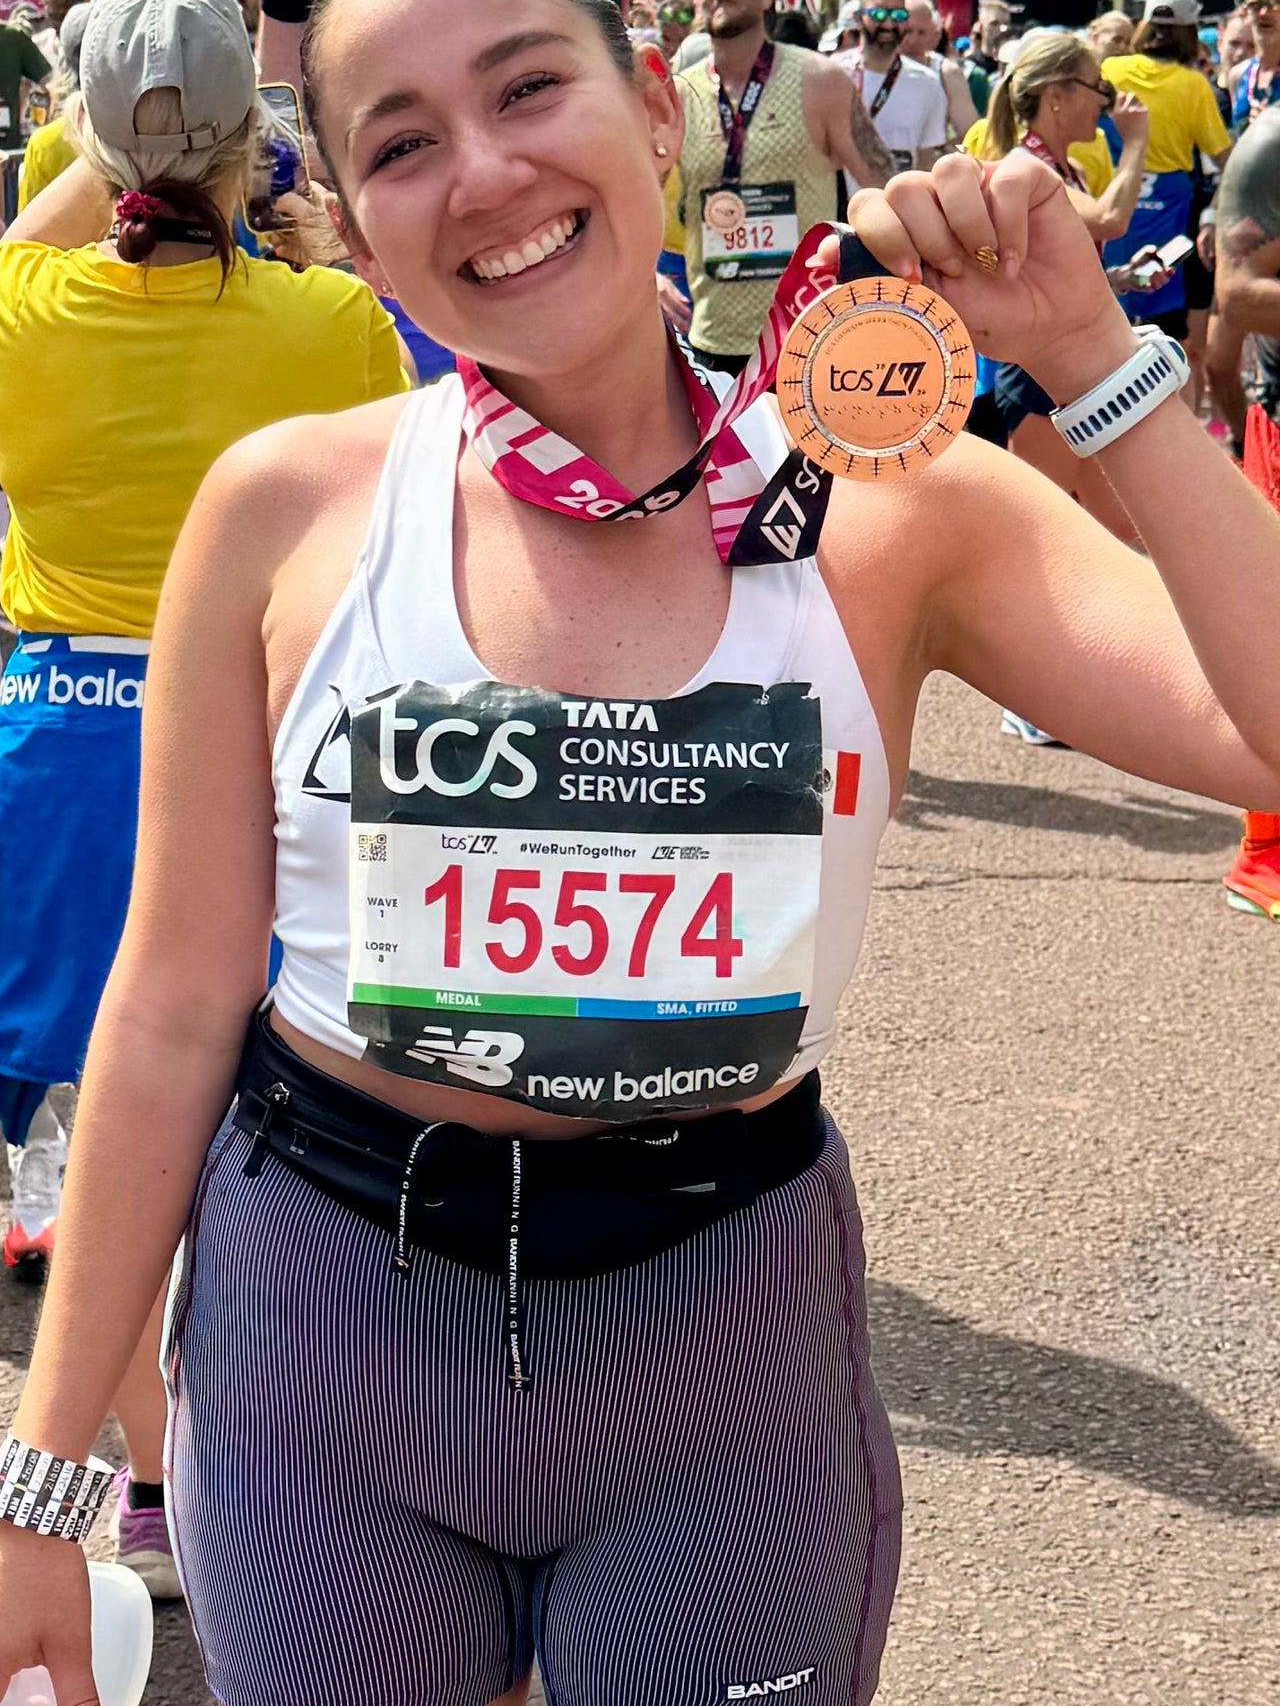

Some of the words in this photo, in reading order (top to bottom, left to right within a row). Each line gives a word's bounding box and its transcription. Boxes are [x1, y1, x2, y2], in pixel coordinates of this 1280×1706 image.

[723, 225, 774, 250] 9812
[829, 364, 873, 392] tcs
[48, 665, 145, 709] bala
[560, 700, 659, 732] TATA
[372, 696, 539, 799] tcs
[559, 738, 789, 769] CONSULTANCY
[557, 775, 706, 805] SERVICES
[441, 833, 467, 850] tcs
[519, 843, 637, 859] #WeRunTogether
[367, 896, 398, 908] WAVE
[424, 863, 744, 978] 15574
[365, 941, 399, 953] LORRY
[436, 992, 481, 1007] MEDAL
[656, 1001, 692, 1016] SMA,
[695, 1000, 737, 1014] FITTED
[527, 1071, 605, 1101] new
[613, 1061, 760, 1102] balance
[726, 1666, 815, 1700] BANDIT
